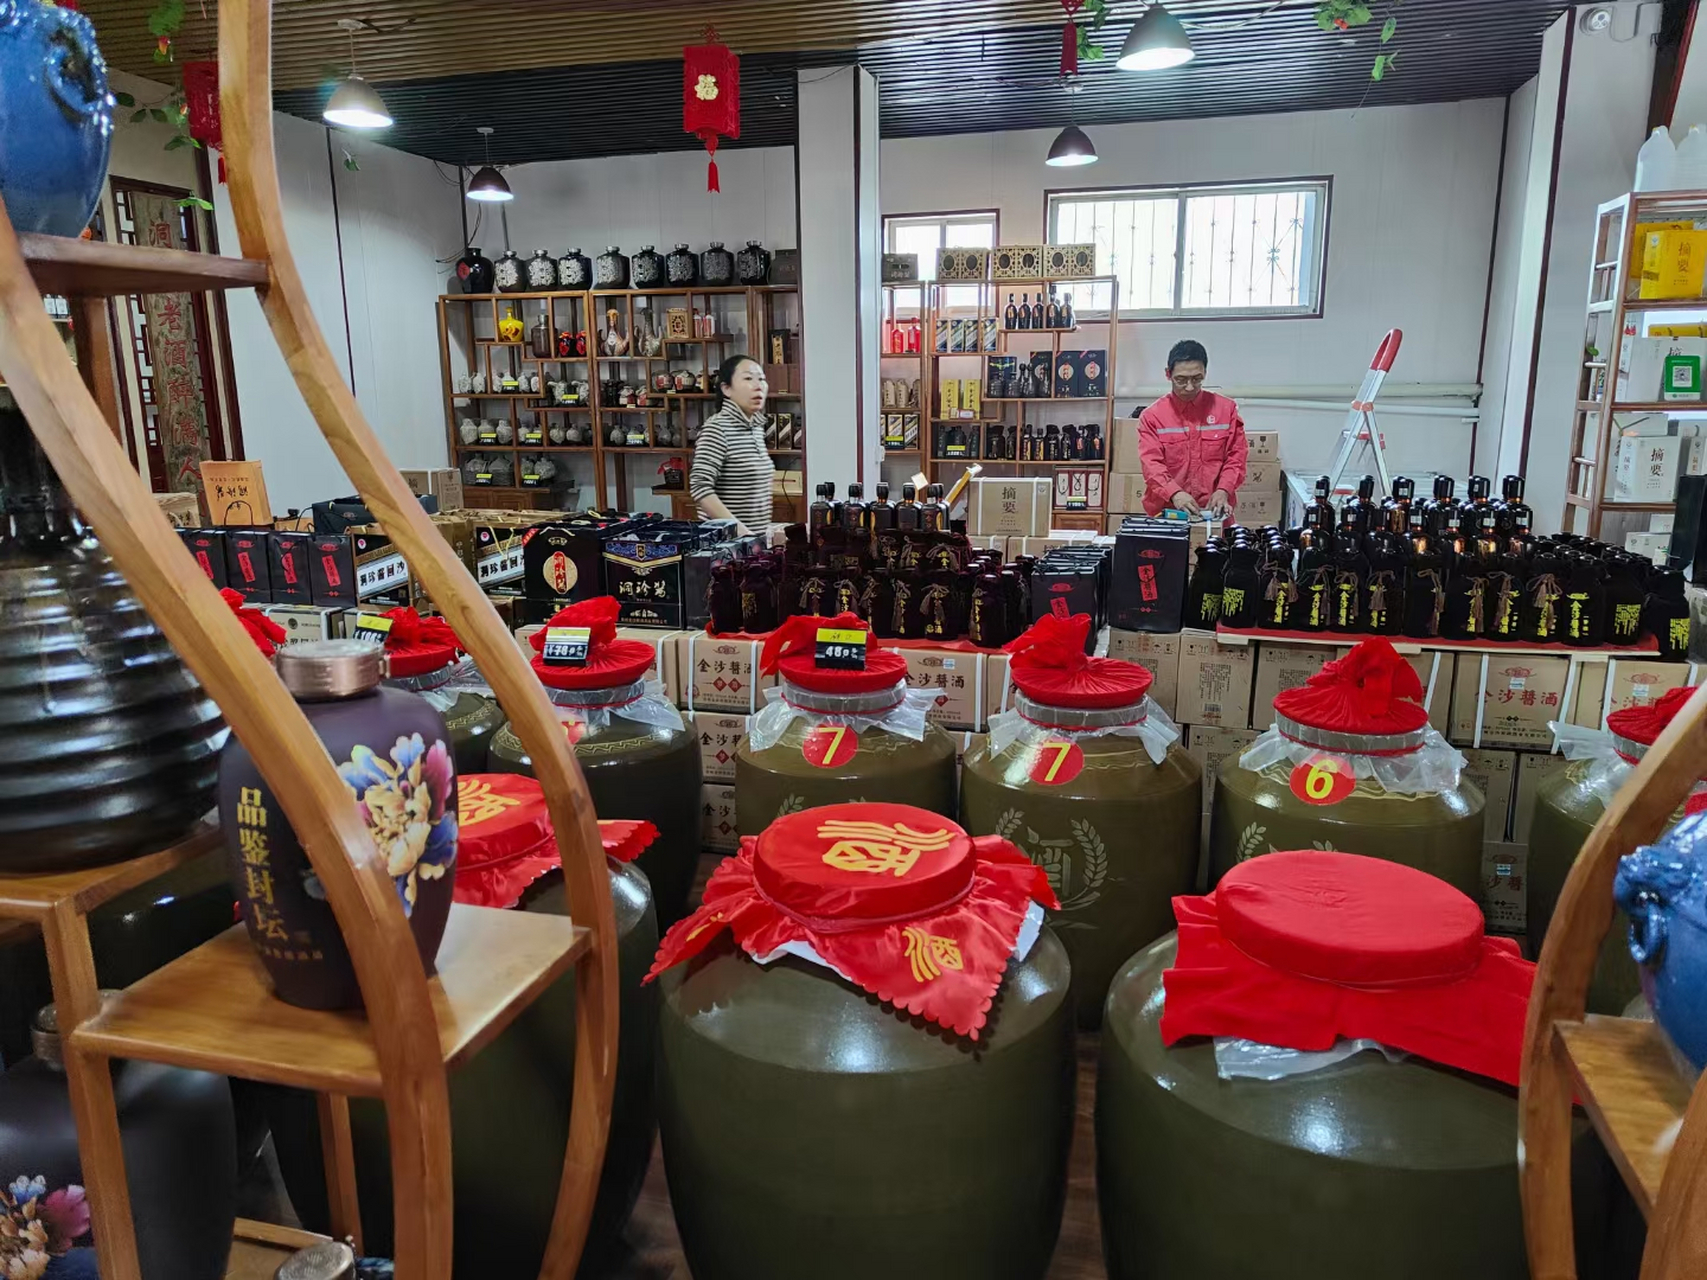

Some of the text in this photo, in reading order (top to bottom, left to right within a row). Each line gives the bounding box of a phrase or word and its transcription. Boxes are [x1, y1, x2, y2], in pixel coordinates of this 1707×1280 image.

[1650, 448, 1665, 477] 摘要
[1001, 486, 1017, 514] 摘要
[818, 726, 846, 766] 7
[1041, 741, 1072, 782] 7
[1304, 758, 1338, 800] 6
[902, 926, 964, 983] 酒
